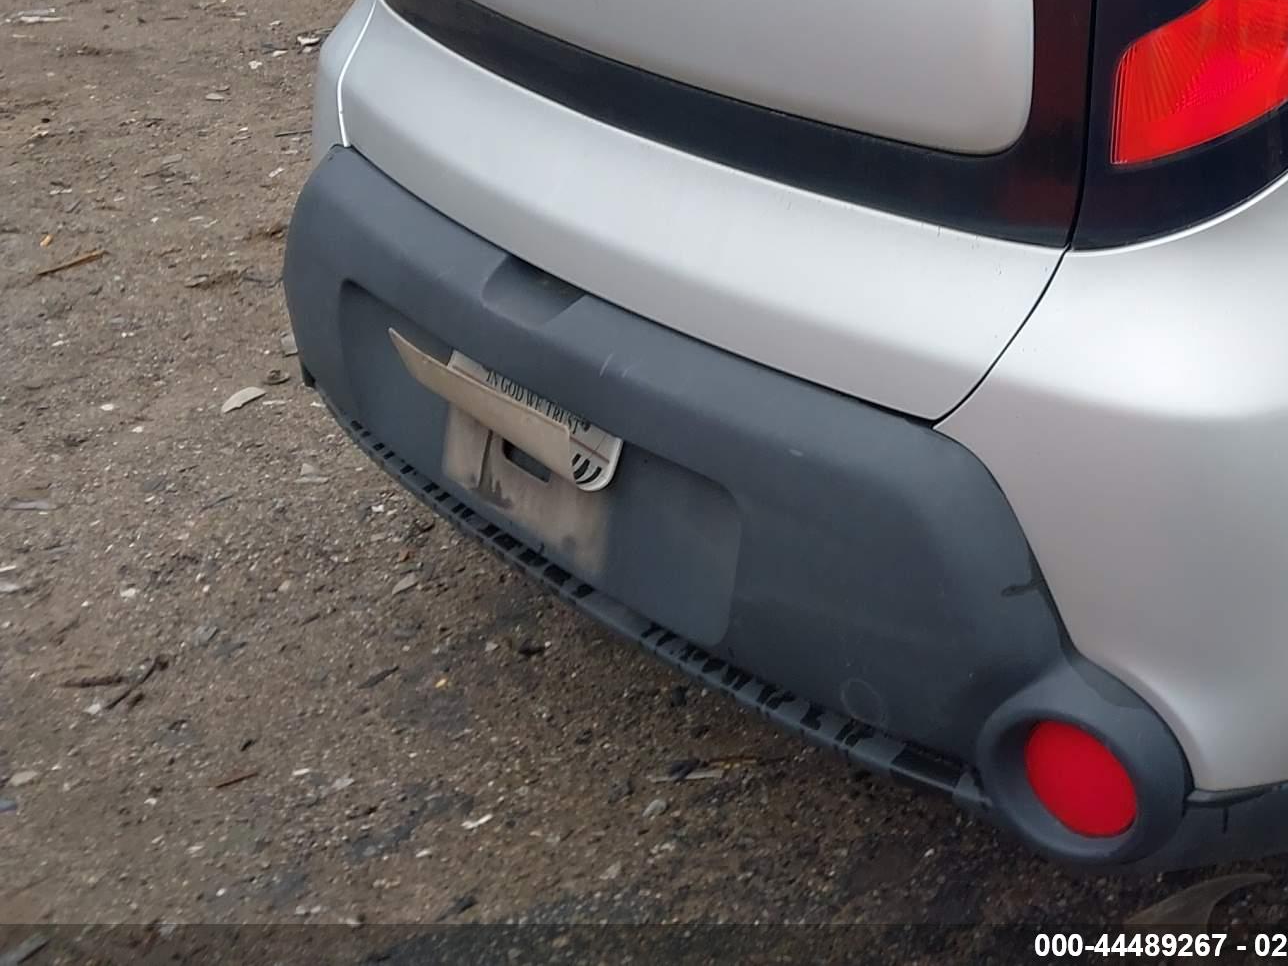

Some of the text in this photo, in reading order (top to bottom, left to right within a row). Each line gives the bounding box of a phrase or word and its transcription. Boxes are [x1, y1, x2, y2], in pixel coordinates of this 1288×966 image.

[486, 369, 580, 435] IN GOD WE TRUST
